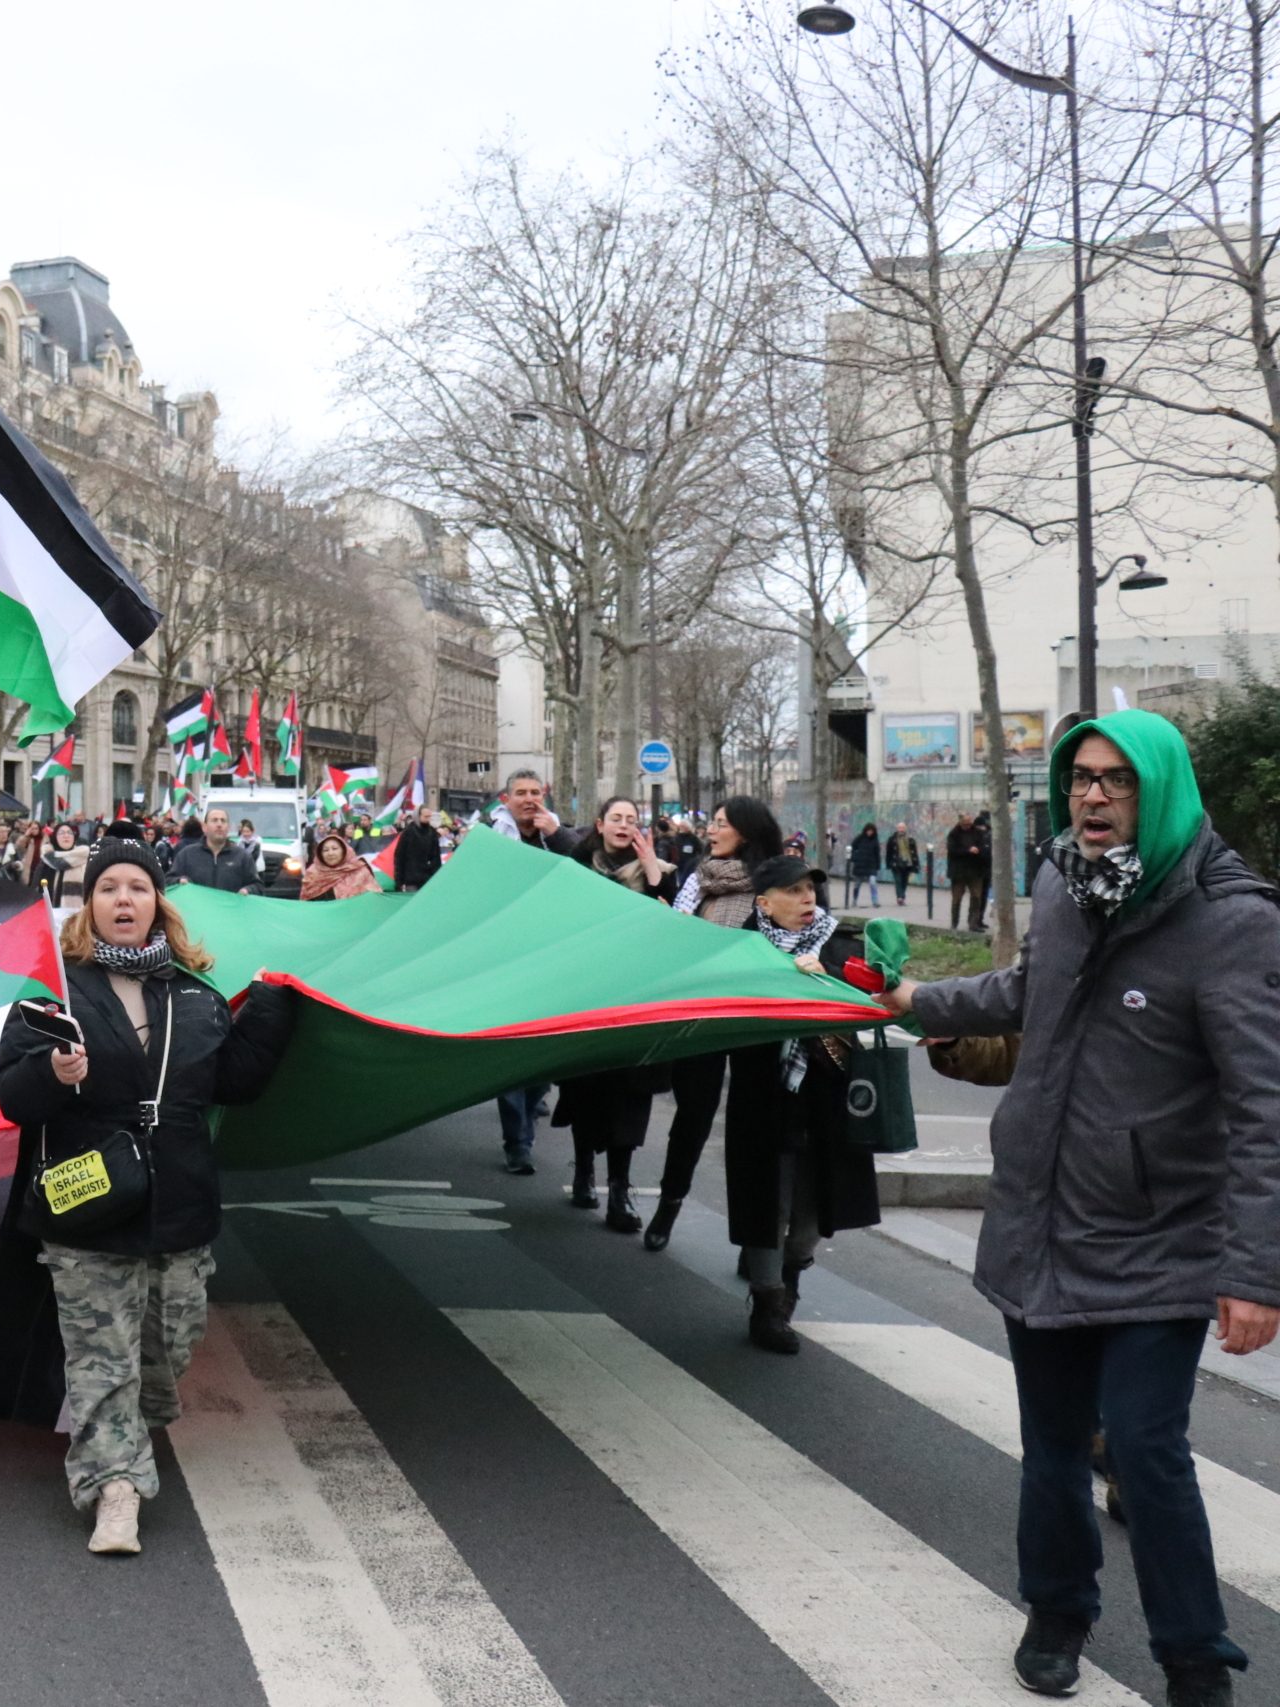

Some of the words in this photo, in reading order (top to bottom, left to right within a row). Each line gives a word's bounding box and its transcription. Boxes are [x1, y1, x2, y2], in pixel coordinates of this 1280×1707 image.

[44, 1153, 96, 1183] BOYCOTT
[53, 1168, 94, 1193] ISRAEL
[53, 1193, 71, 1210] ETAT
[71, 1178, 108, 1201] RACISTE
